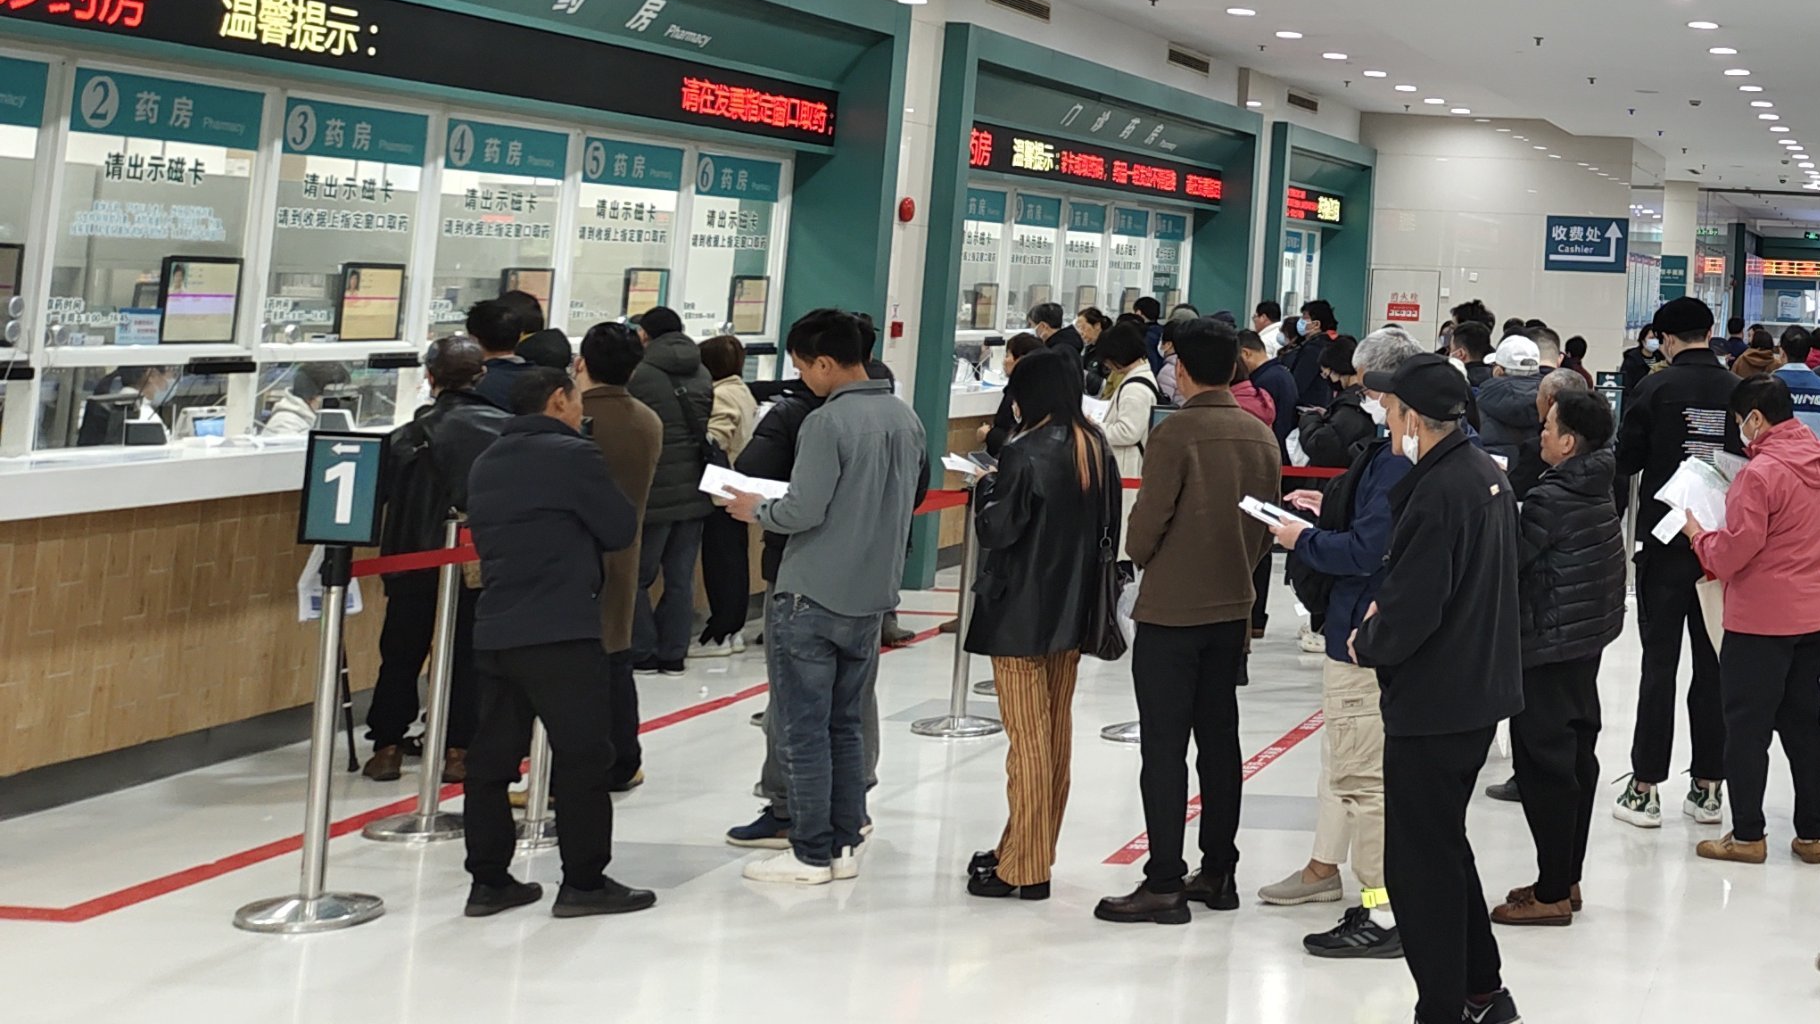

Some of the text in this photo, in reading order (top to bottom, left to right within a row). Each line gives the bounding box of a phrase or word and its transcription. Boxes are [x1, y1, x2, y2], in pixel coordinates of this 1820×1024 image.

[664, 23, 713, 48] Pharmacy
[134, 89, 194, 129] 药房
[203, 116, 246, 137] Pharmacy
[324, 118, 372, 152] 药房
[484, 137, 522, 167] 药房
[614, 153, 646, 179] 药房
[105, 152, 206, 185] 请出示磁卡
[721, 167, 748, 192] 药房
[303, 173, 395, 203] 请出示磁卡
[1552, 225, 1601, 242] 收费处
[1557, 244, 1594, 254] Cashier
[323, 460, 357, 525] 1
